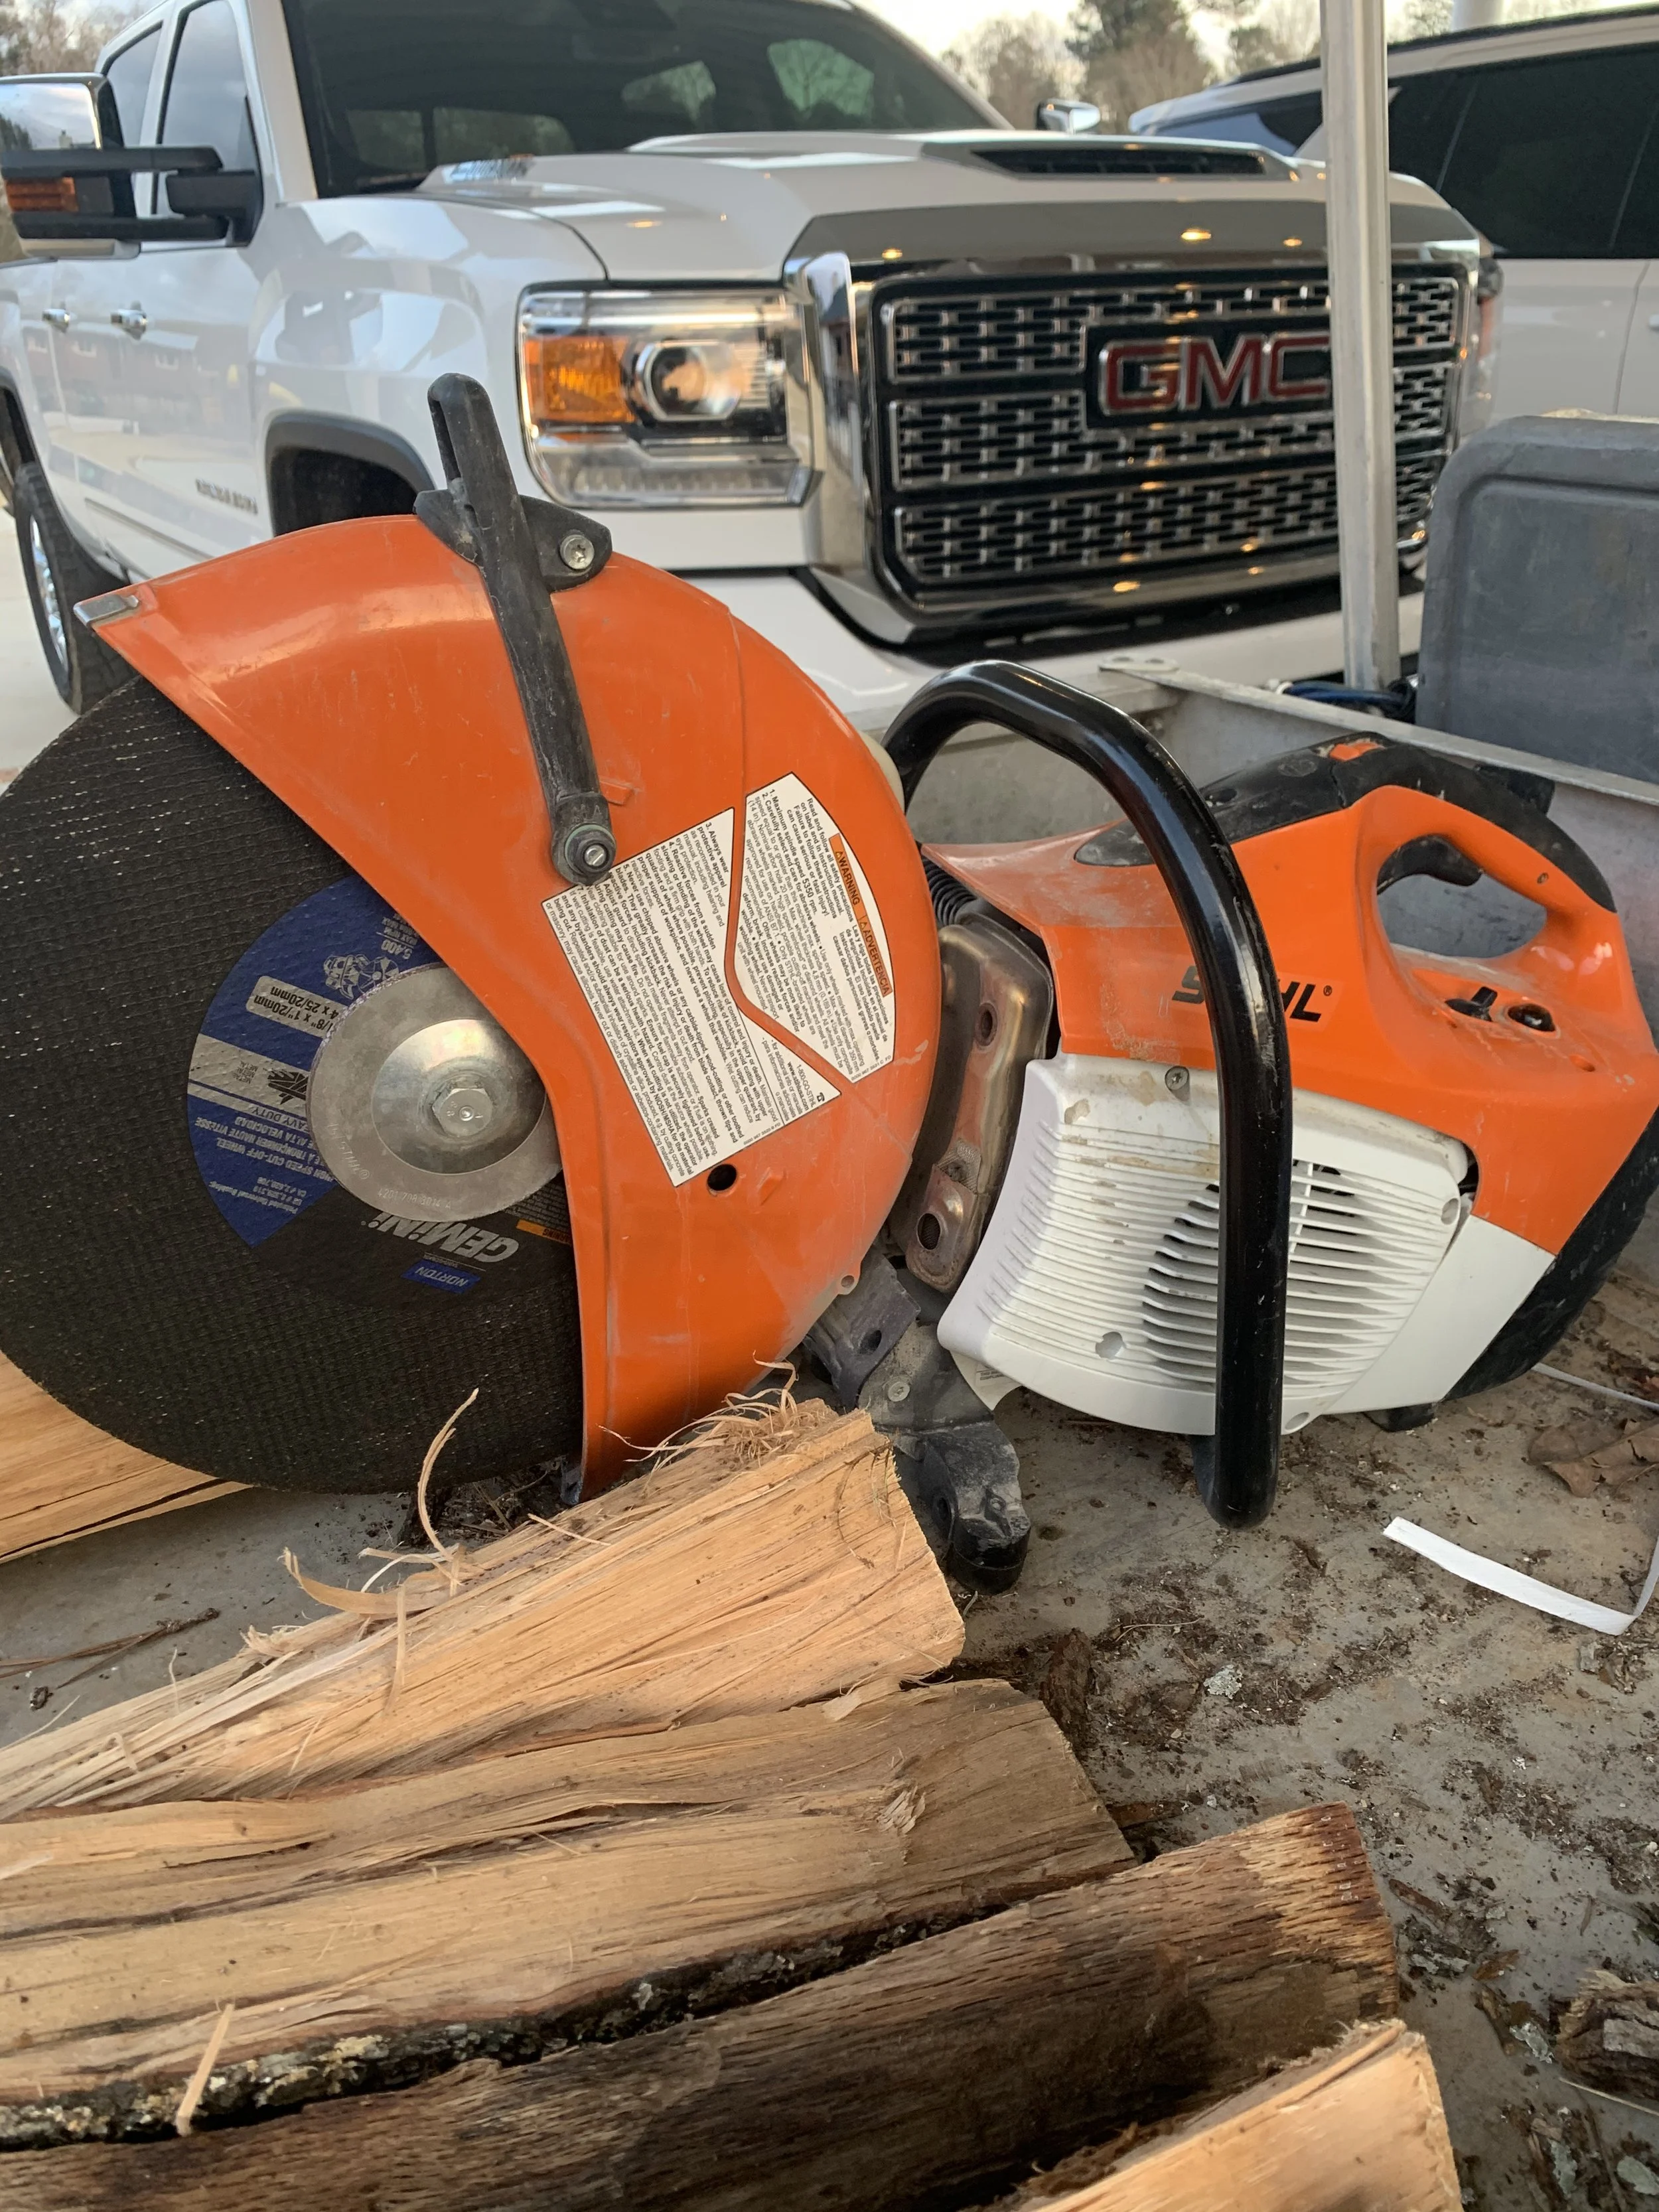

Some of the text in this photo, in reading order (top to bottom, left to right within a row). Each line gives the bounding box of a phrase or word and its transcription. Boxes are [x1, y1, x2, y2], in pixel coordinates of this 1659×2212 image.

[1098, 330, 1330, 416] GMC
[807, 798, 818, 816] Read
[814, 817, 823, 831] and
[707, 829, 723, 856] Always
[718, 856, 728, 873] wear
[818, 831, 831, 853] follow
[660, 844, 676, 873] slowing
[697, 826, 727, 888] protective apparel
[771, 796, 788, 830] Maximum
[783, 830, 798, 857] spindle
[792, 856, 806, 878] speed
[800, 878, 814, 898] 5350
[808, 899, 818, 915] rpm.
[786, 808, 830, 917] can cause serious or fatal injury!
[794, 804, 838, 919] Failure to follow these instructions
[804, 812, 815, 830] label
[810, 830, 820, 844] and
[818, 851, 835, 889] instruction
[831, 888, 845, 915] manual.
[672, 873, 679, 881] or
[828, 862, 841, 883] safety
[837, 857, 861, 905] WARNING
[672, 848, 688, 879] Reactive
[684, 879, 697, 901] forces
[693, 901, 704, 919] from
[702, 924, 717, 950] sudden
[675, 881, 691, 909] binding
[836, 883, 855, 922] precautions
[687, 908, 694, 917] of
[690, 916, 699, 928] the
[695, 928, 708, 948] wheel
[851, 924, 860, 937] Lea
[703, 948, 713, 964] may
[857, 942, 867, 957] siga
[861, 929, 891, 995] ADVERTENCIA
[862, 956, 873, 974] todas
[709, 963, 721, 983] cause
[868, 974, 877, 985] las
[718, 982, 728, 998] loss
[838, 931, 859, 976] instrucciones.
[861, 995, 875, 1022] indebido
[869, 1021, 881, 1041] puede
[847, 937, 864, 969] seguridad
[859, 968, 873, 997] incluidas
[874, 1011, 886, 1034] manual
[252, 995, 301, 1021] 1"/20mm
[269, 986, 321, 1013] 25/20mm
[626, 871, 640, 893] Never
[636, 893, 644, 907] use
[640, 906, 658, 935] chipped
[654, 934, 670, 964] abrasive
[666, 963, 680, 986] wheels
[678, 995, 687, 1008] any
[684, 1007, 709, 1054] carbide-tipped,
[703, 1053, 725, 1093] wood-cutting
[724, 1099, 735, 1116] other
[731, 1115, 745, 1138] toothed
[724, 997, 731, 1005] of
[871, 985, 890, 1025] precauciones
[303, 1013, 311, 1023] x
[727, 1004, 741, 1028] control
[581, 893, 601, 929] Inhalation
[600, 936, 611, 954] dust
[607, 953, 616, 967] can
[620, 982, 635, 1007] serious
[631, 1006, 644, 1027] health
[640, 1027, 655, 1051] hazard.
[651, 1050, 665, 1072] Control
[660, 1071, 671, 1086] dust
[670, 1091, 678, 1102] the
[674, 1102, 685, 1121] source
[682, 1120, 694, 1138] where
[689, 1138, 705, 1161] possible.
[736, 1027, 745, 1040] and
[740, 1039, 753, 1059] injury
[235, 1066, 255, 1078] METAL
[238, 1061, 258, 1072] METAL
[751, 1065, 763, 1084] death.
[232, 1072, 252, 1084] METAL
[787, 1061, 810, 1111] www.stihlusa.com
[759, 1083, 772, 1108] Maintain
[252, 1105, 281, 1122] DUTY
[767, 1107, 778, 1122] good
[194, 1115, 228, 1136] VITESSE
[228, 1127, 256, 1144] HAUTE
[234, 1114, 307, 1146] ALTA VELOCIDAD
[214, 1136, 246, 1155] WHEEL
[246, 1145, 285, 1167] CUT-OFF
[285, 1158, 313, 1175] SPEED
[414, 1266, 469, 1287] NORTON
